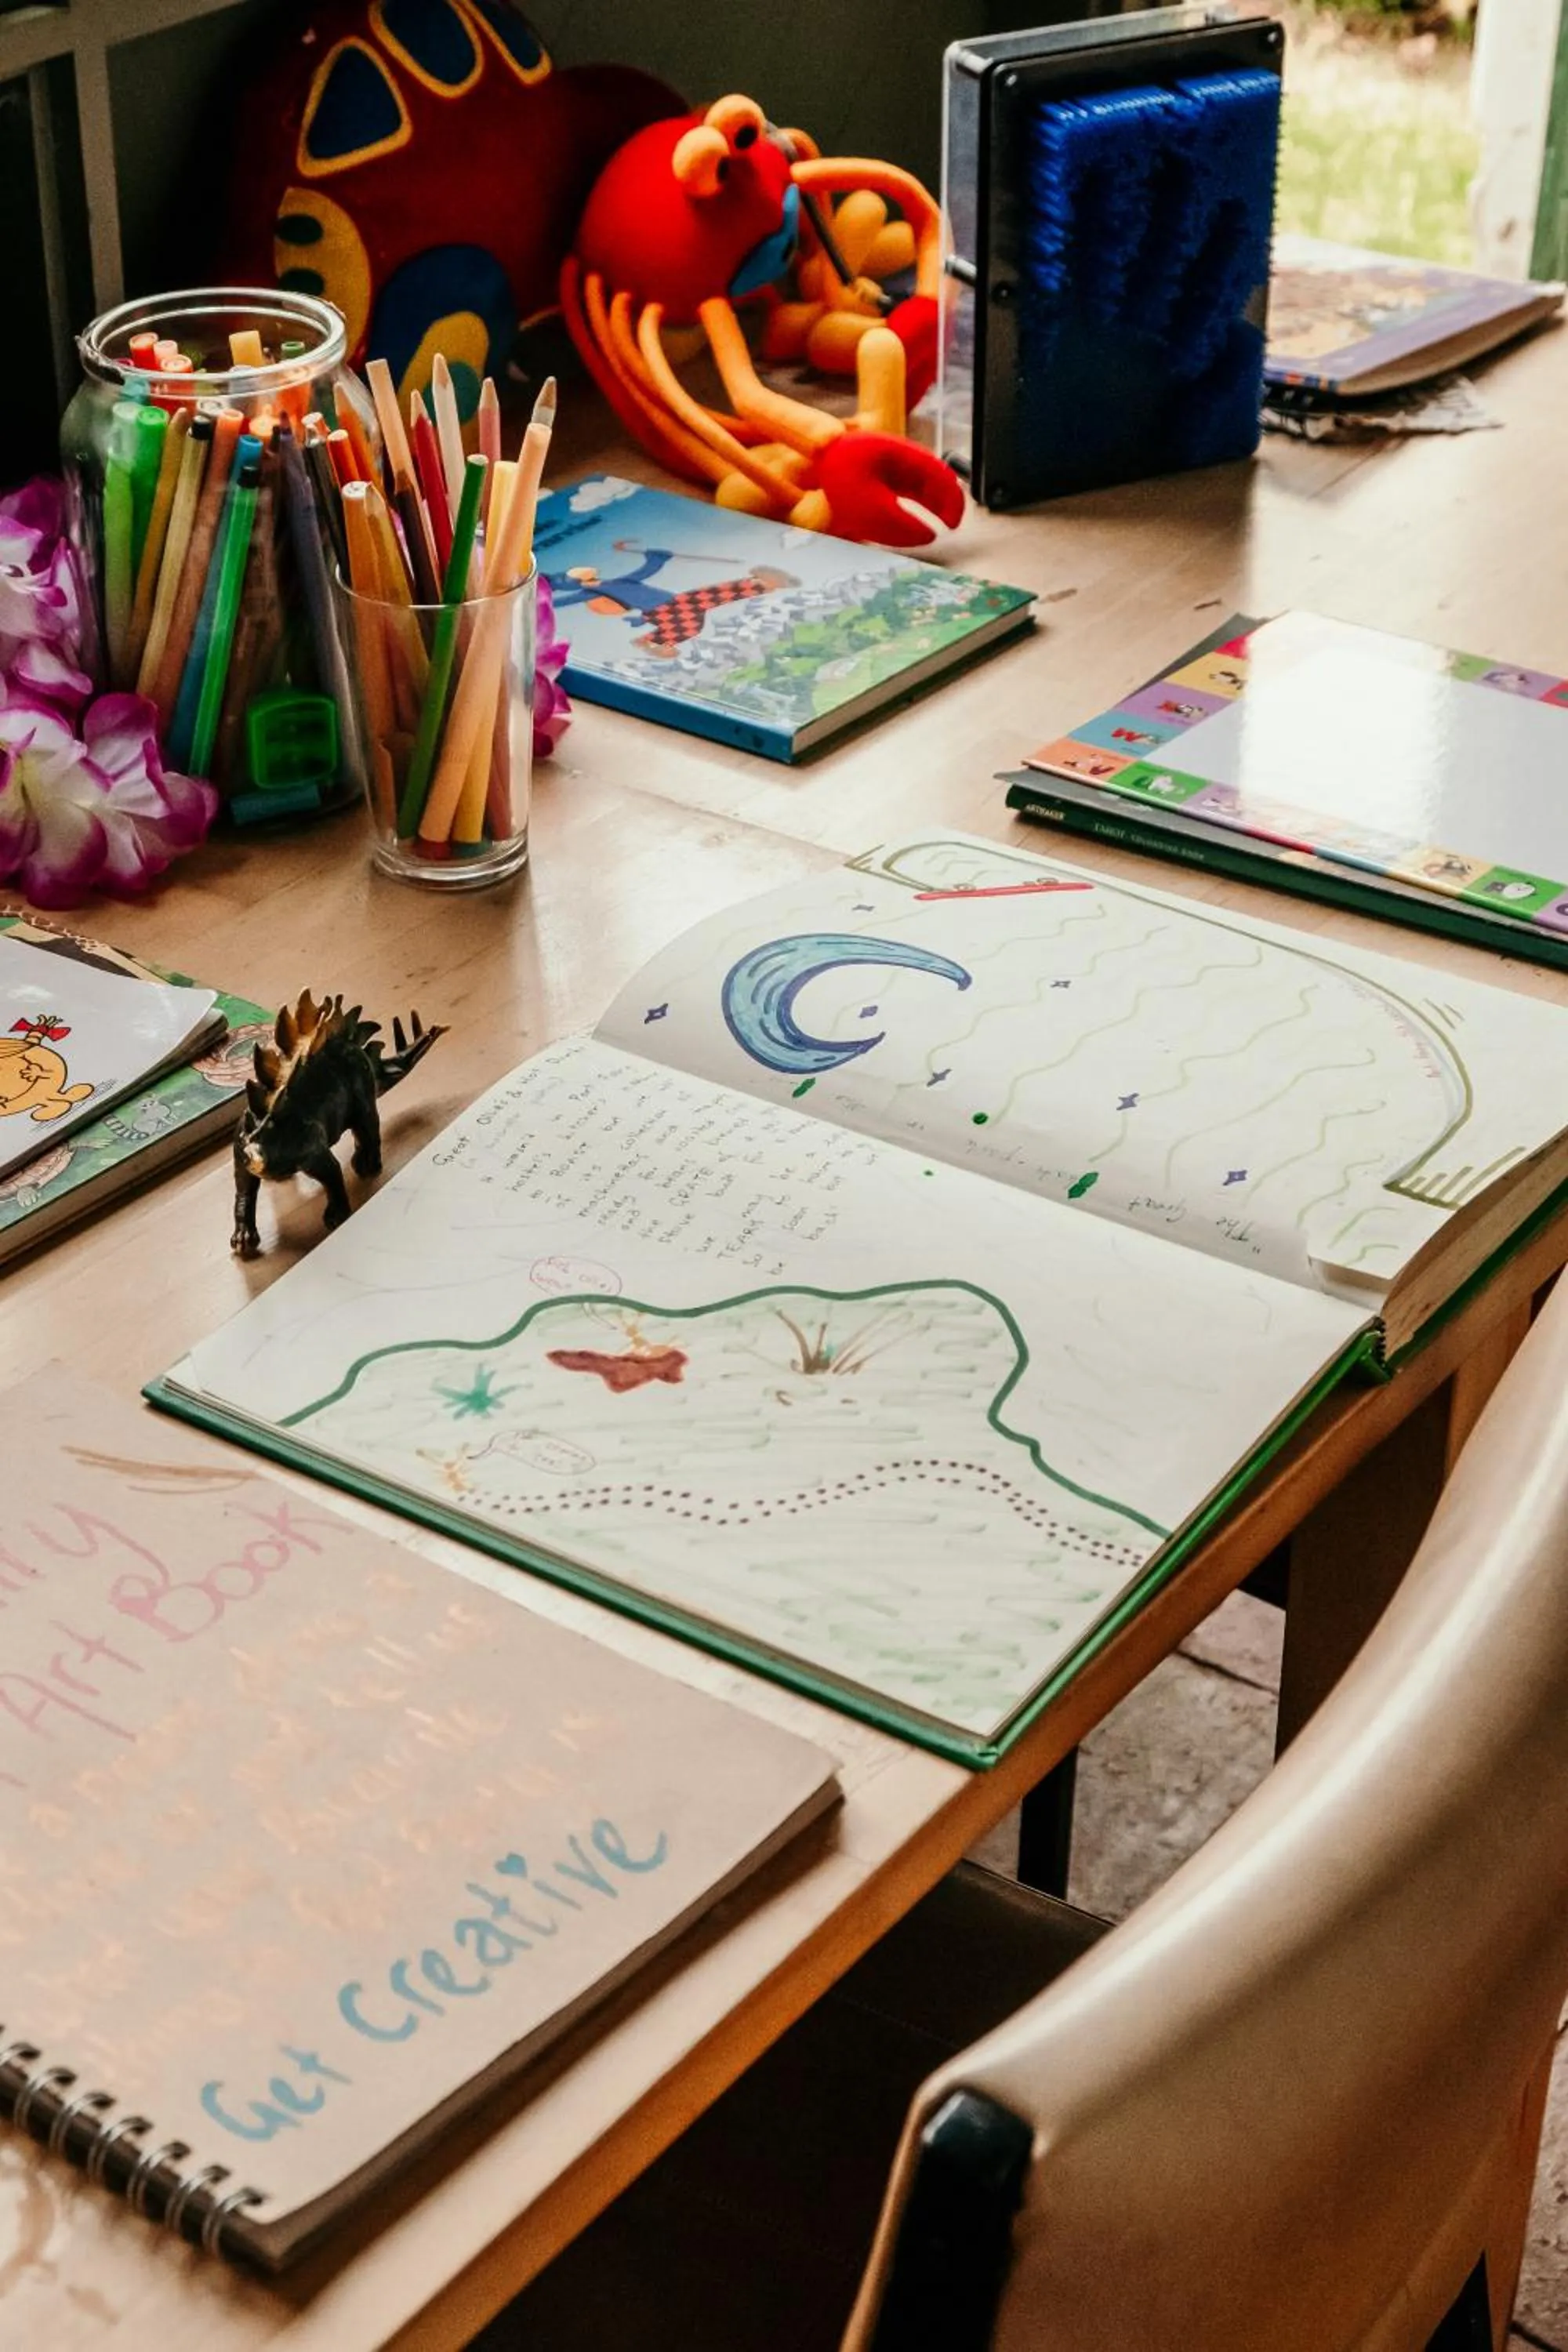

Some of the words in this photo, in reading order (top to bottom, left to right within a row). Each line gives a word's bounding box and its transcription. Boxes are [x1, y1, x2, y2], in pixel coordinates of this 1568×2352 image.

[0, 1618, 146, 1744] Art
[108, 1500, 357, 1643] Book
[199, 2043, 353, 2142] Get
[337, 1817, 669, 2043] Creative
